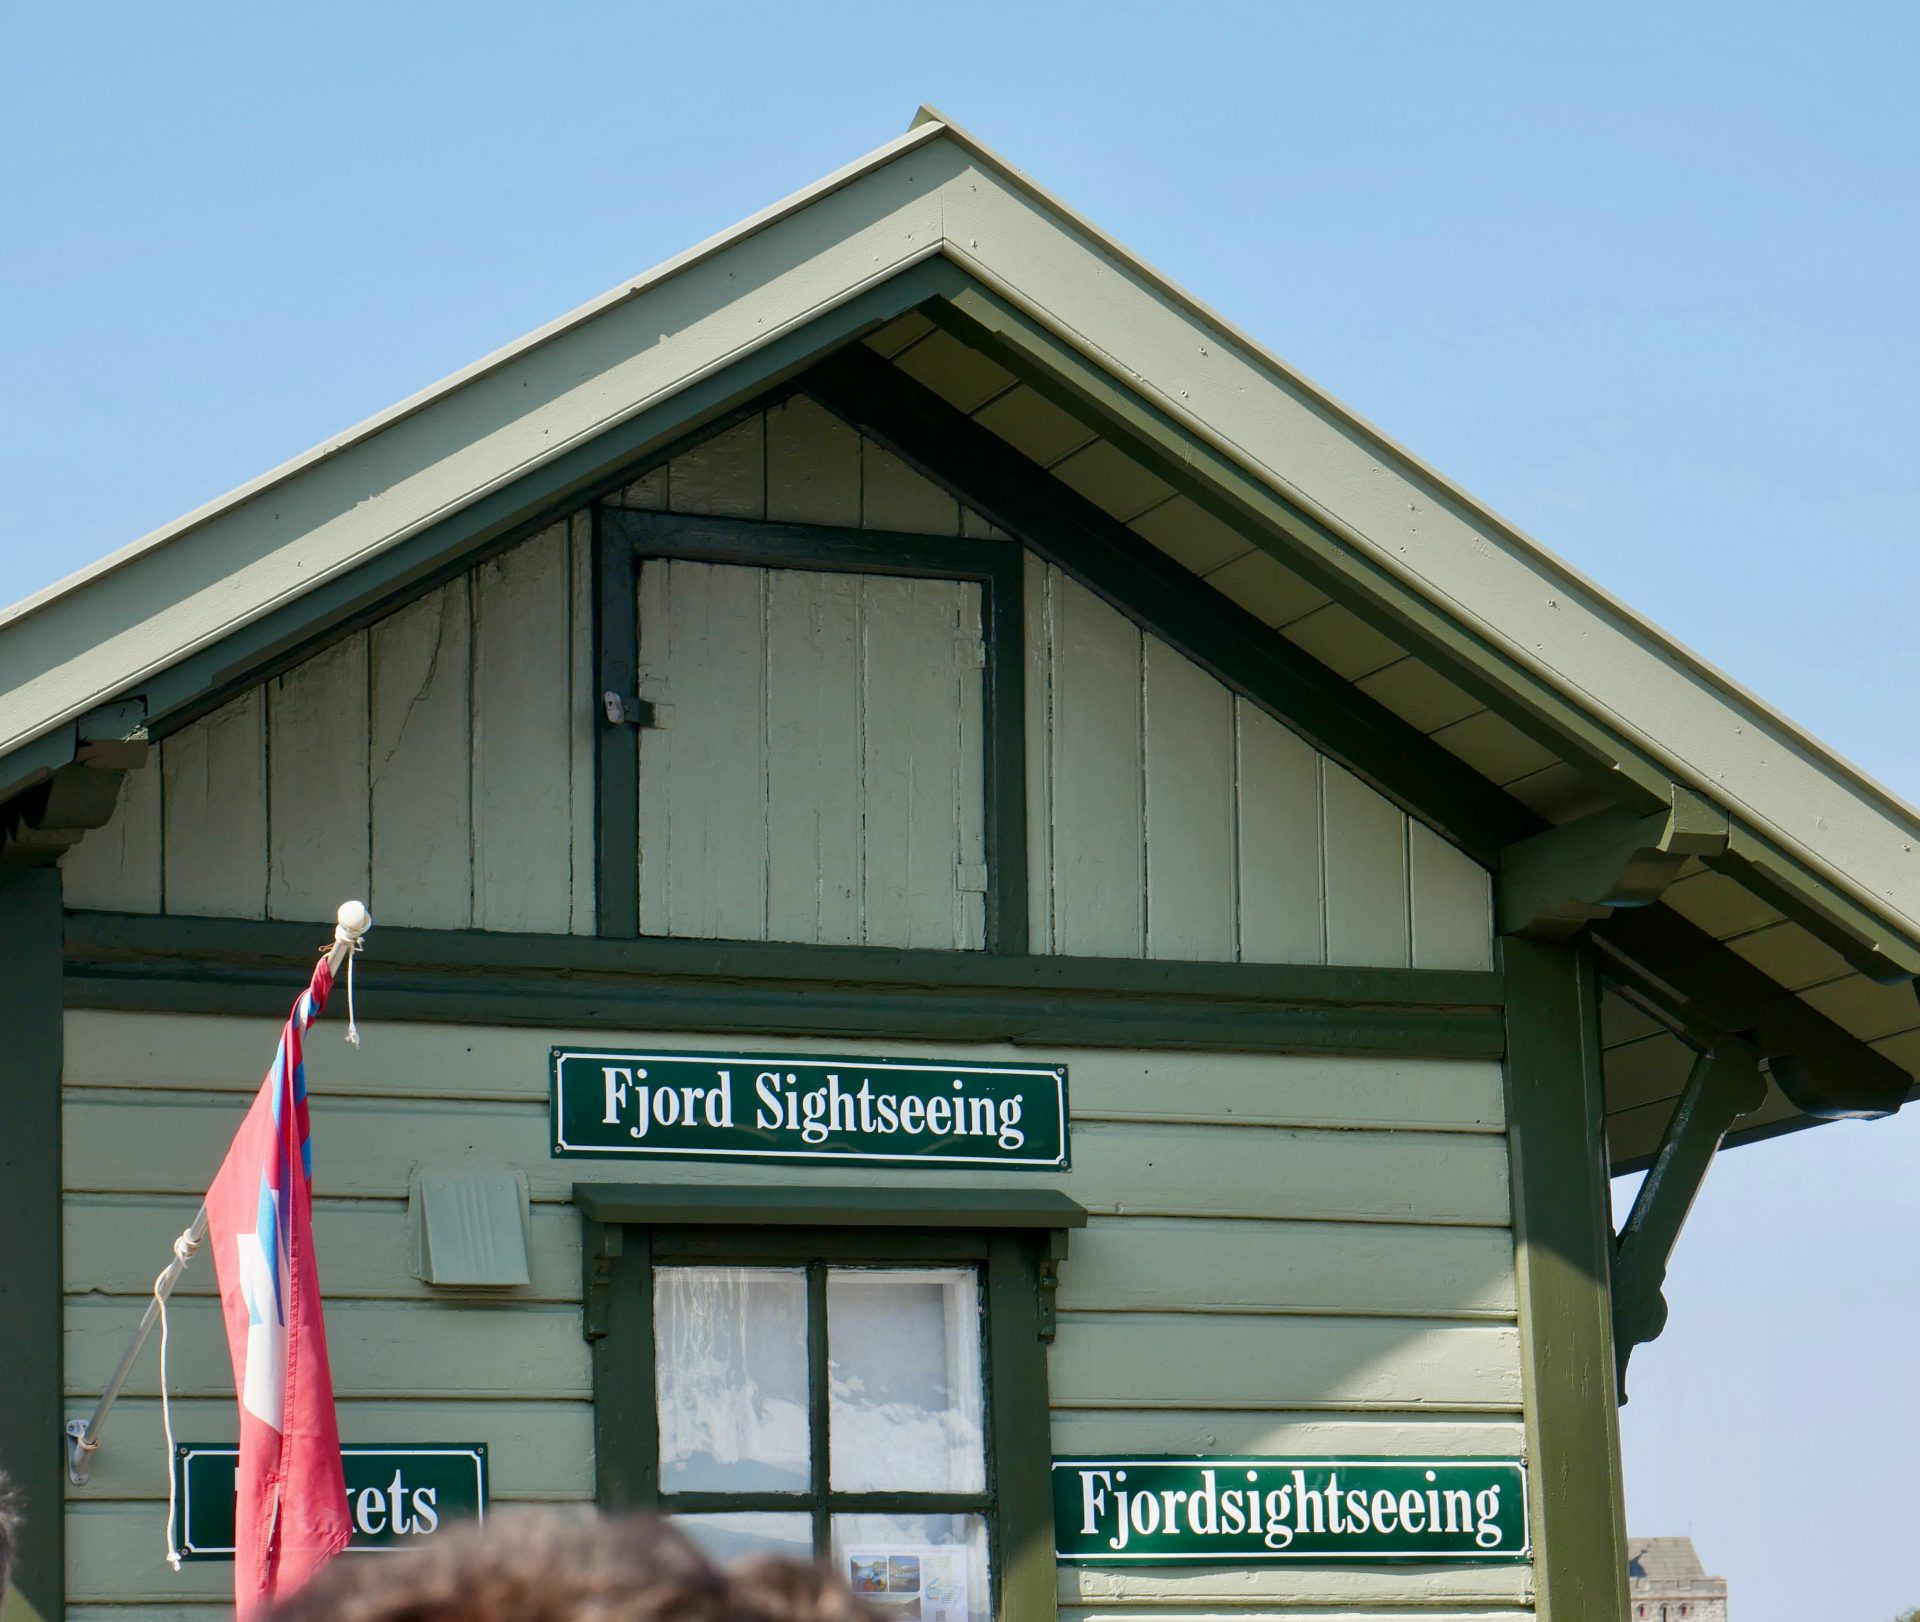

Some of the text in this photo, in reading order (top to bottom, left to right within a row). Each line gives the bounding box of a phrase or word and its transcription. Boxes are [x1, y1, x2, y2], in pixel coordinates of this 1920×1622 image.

[601, 1067, 1025, 1150] Fjord Sightseeing
[1078, 1469, 1503, 1550] Fjordsightseeing
